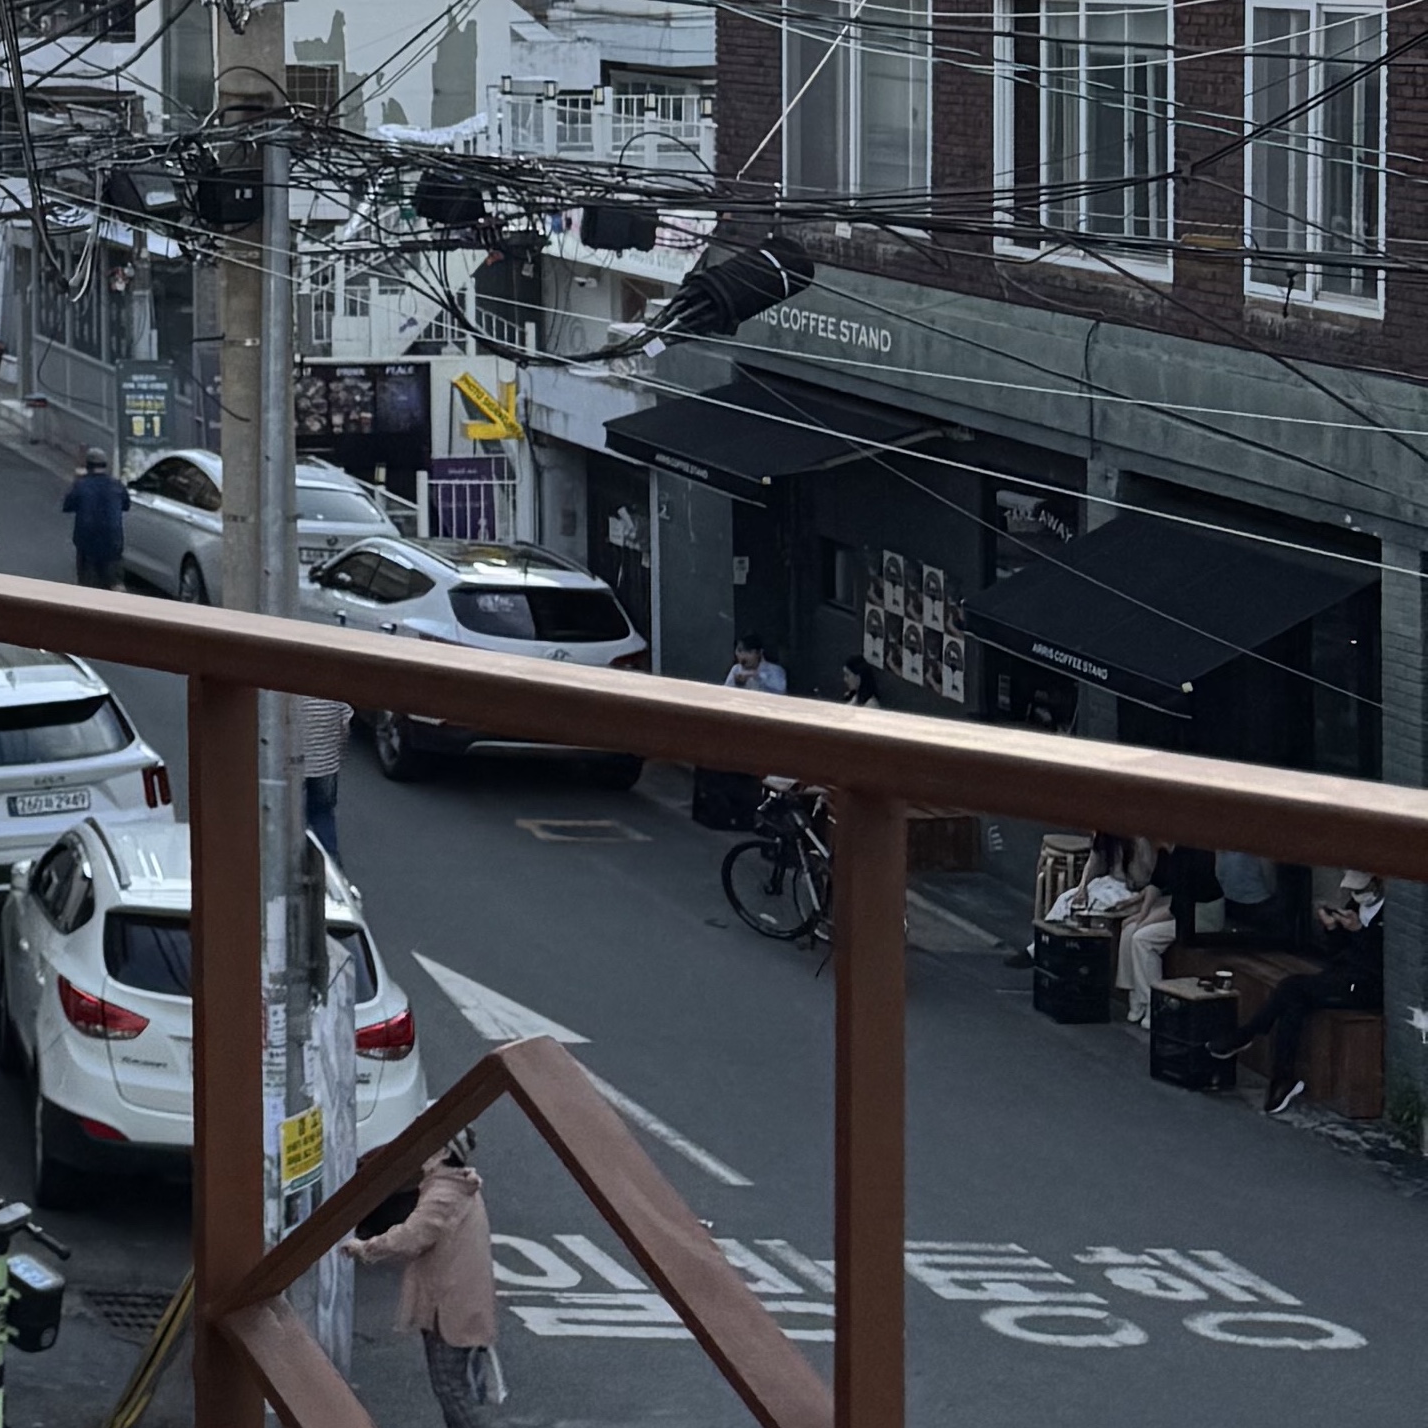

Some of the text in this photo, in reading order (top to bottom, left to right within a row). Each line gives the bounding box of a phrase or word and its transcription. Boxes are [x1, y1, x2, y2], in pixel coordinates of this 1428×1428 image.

[780, 306, 837, 340] COFFEE
[839, 320, 892, 353] STAND
[1039, 509, 1073, 544] AWAY
